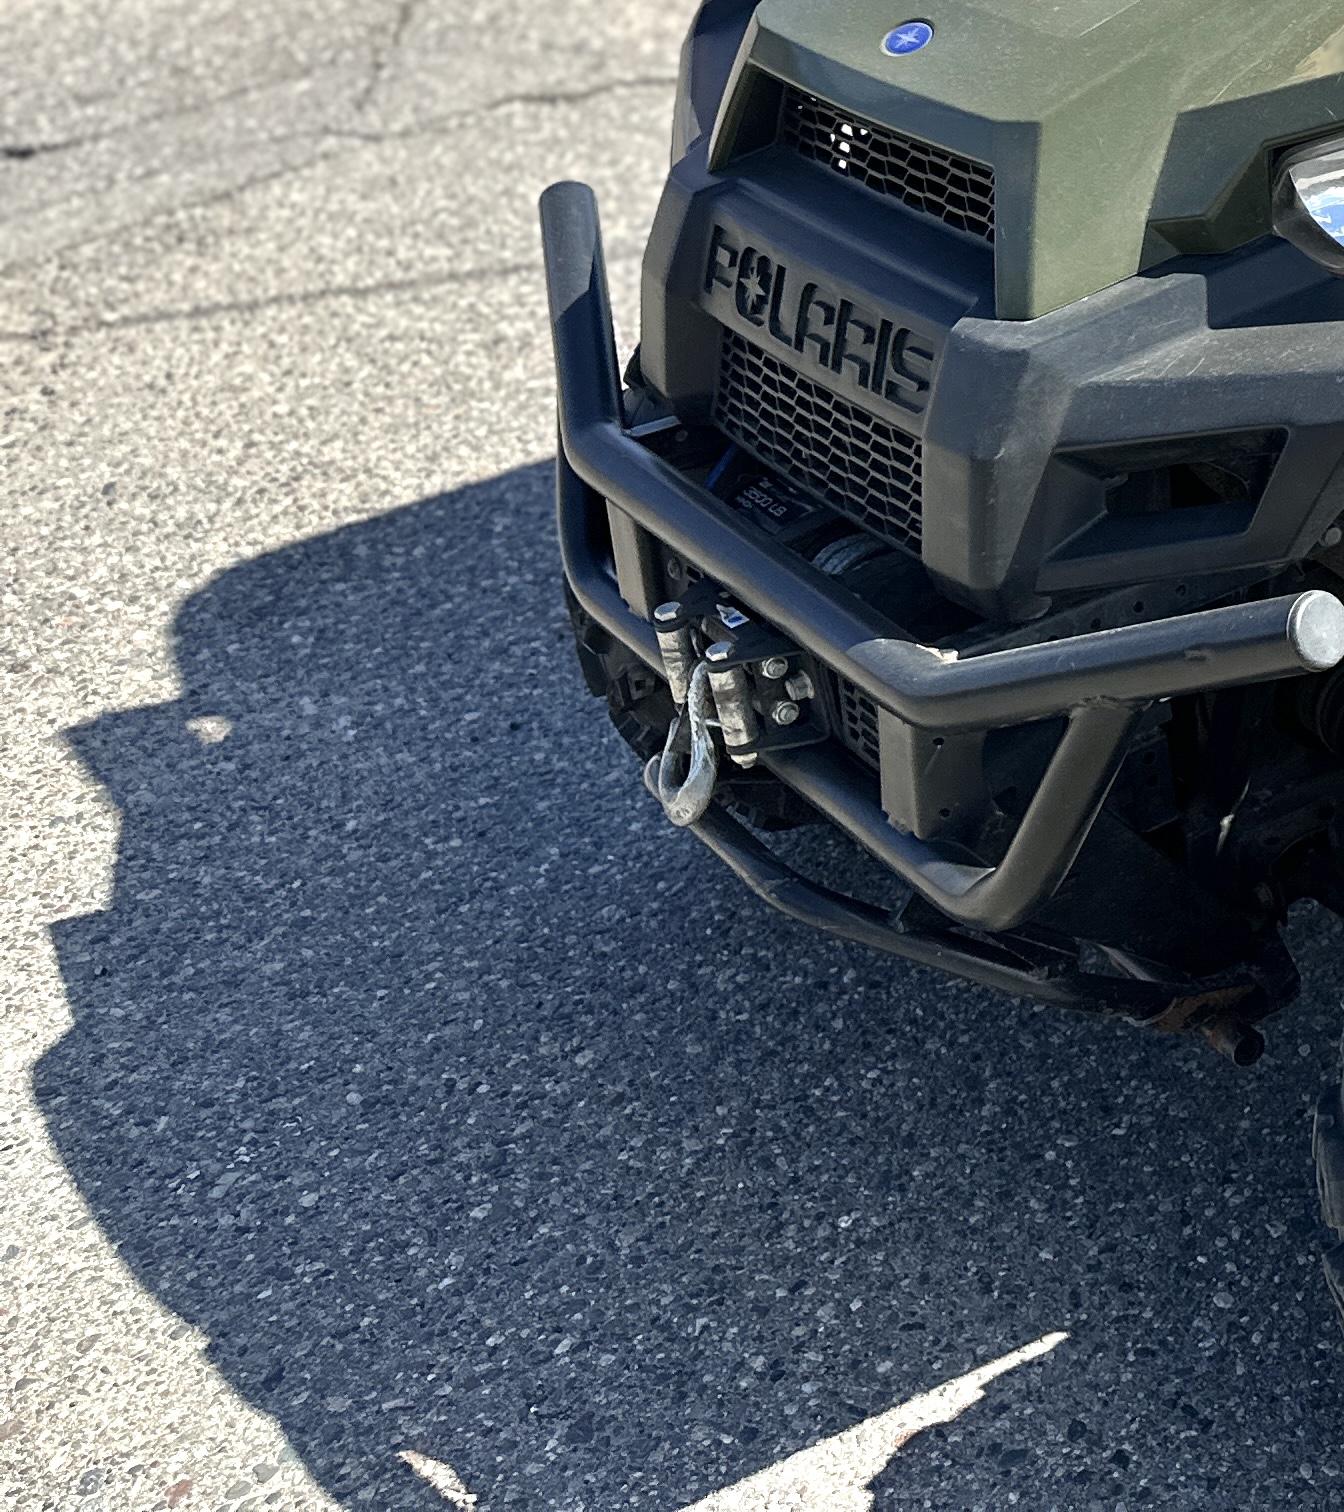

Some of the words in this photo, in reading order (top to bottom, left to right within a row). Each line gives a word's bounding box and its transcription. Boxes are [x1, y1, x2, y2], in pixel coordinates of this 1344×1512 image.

[703, 224, 936, 416] POLARIS
[742, 486, 774, 508] 3500
[767, 502, 788, 518] LB
